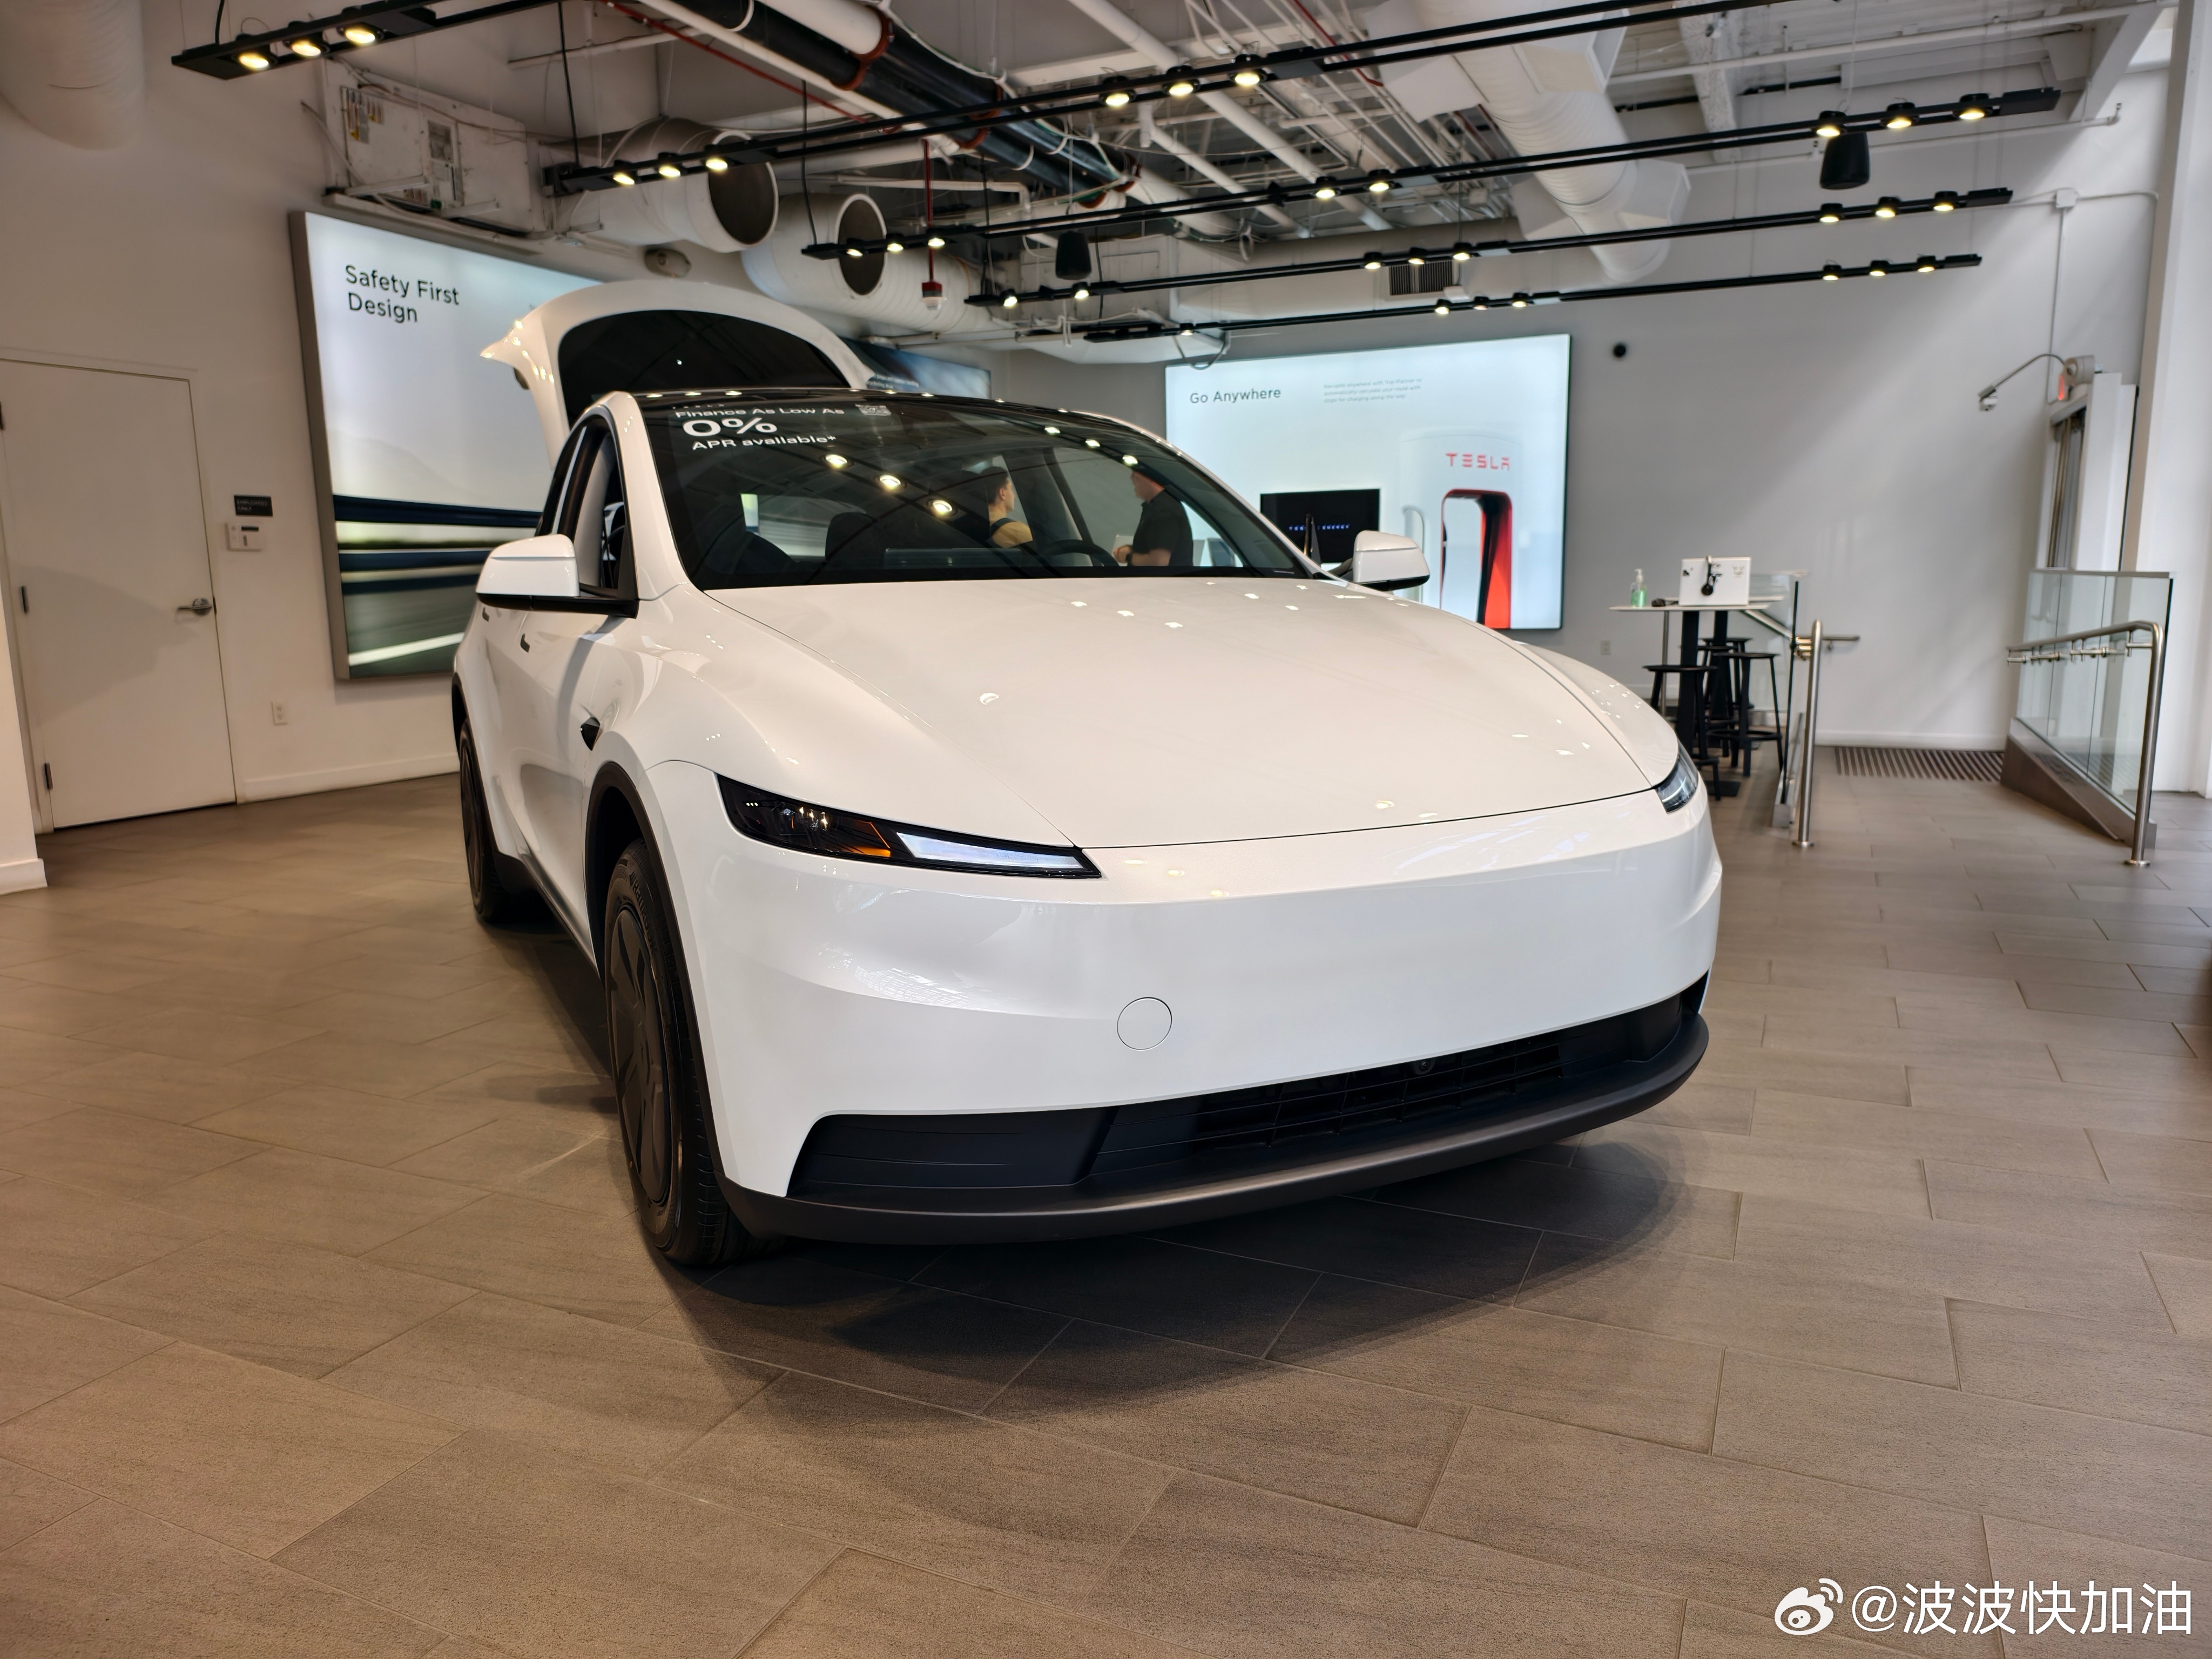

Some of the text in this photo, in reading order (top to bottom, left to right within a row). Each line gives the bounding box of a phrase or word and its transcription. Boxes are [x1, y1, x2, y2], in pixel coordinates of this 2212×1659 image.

[346, 265, 460, 306] Safety First
[348, 292, 417, 324] Design
[1190, 388, 1282, 404] Go Anywhere
[675, 409, 746, 418] Finance
[682, 417, 778, 437] 0%
[692, 439, 737, 450] APR
[1446, 452, 1510, 471] TESLA
